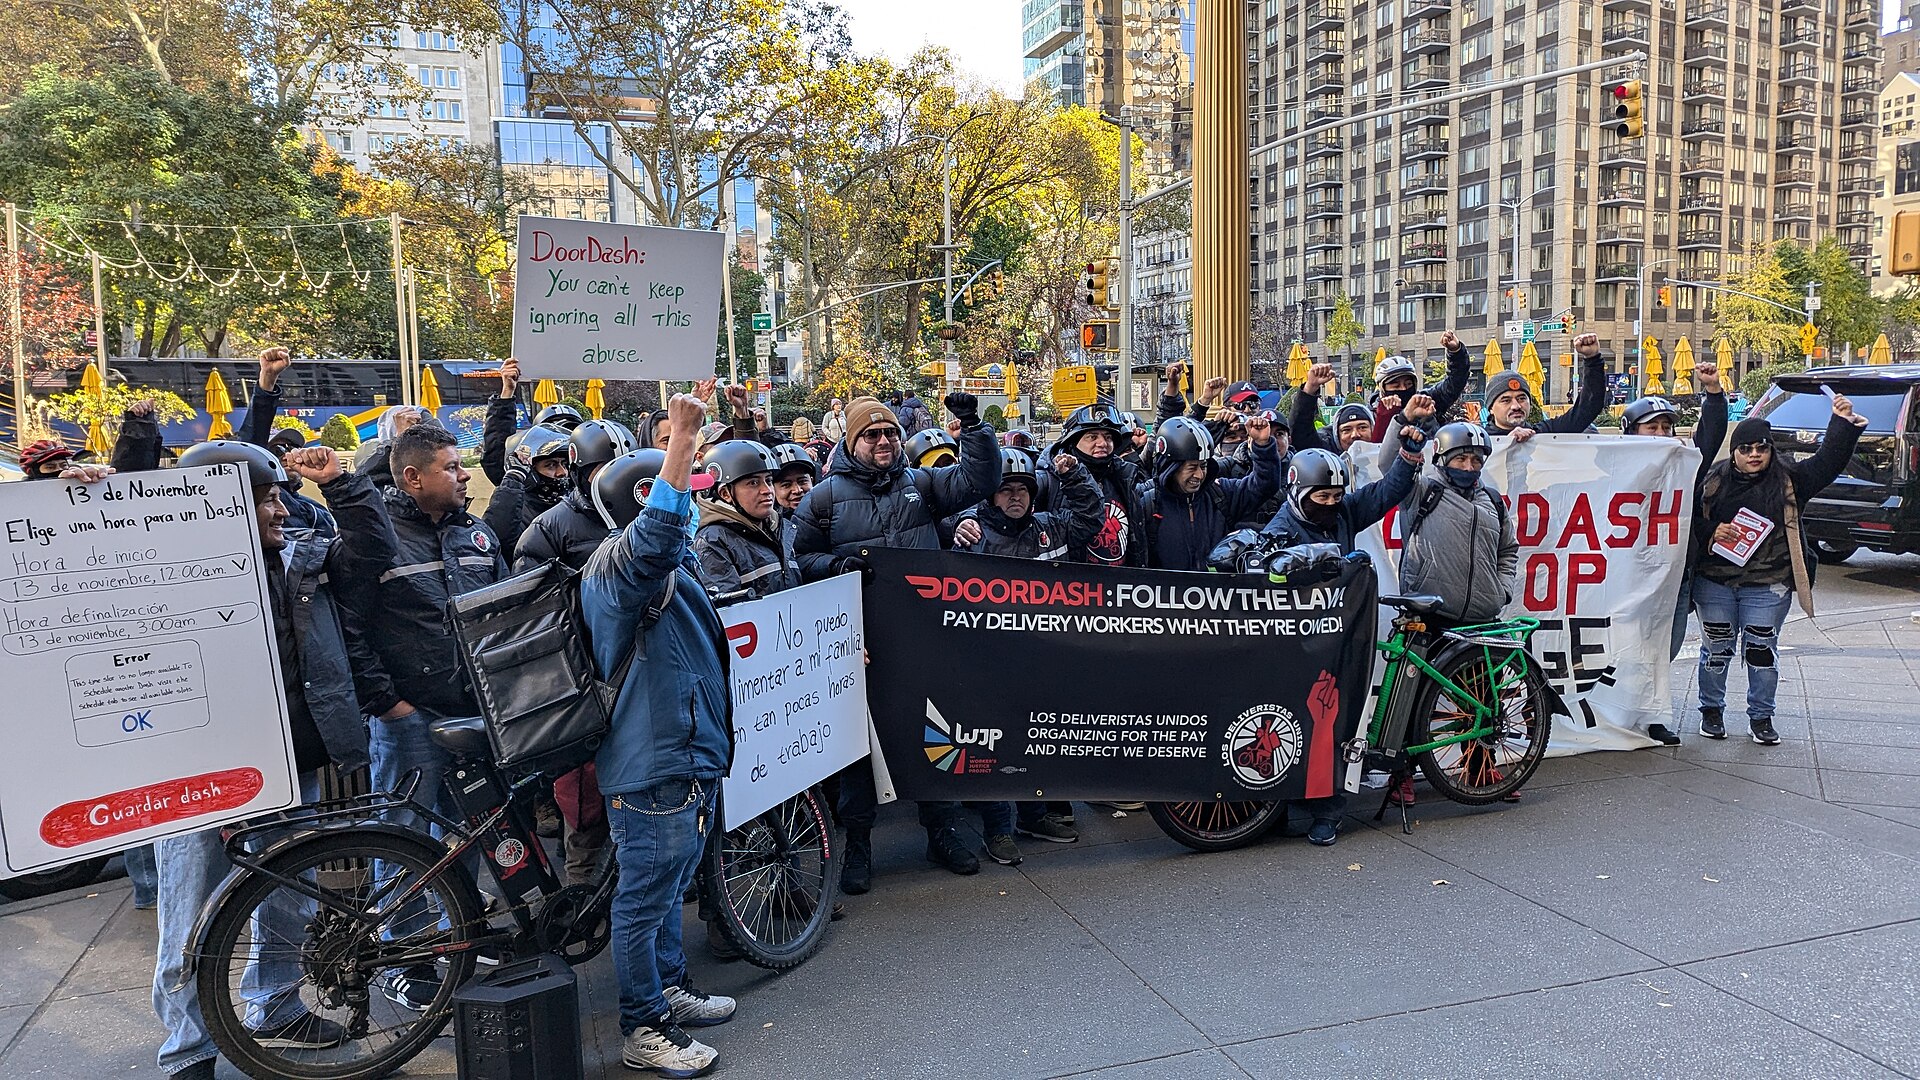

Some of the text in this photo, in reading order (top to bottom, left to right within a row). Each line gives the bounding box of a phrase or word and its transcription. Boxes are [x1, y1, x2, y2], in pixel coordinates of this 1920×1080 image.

[530, 231, 646, 264] DoorDash:
[545, 269, 580, 298] You
[586, 274, 630, 296] can't
[529, 307, 600, 333] ignoring
[614, 303, 637, 327] all
[582, 343, 643, 364] abuse.
[298, 408, 315, 416] NY
[65, 475, 208, 506] 13 de Noviembre
[6, 496, 245, 545] Elige una hora para un Dash
[12, 546, 158, 576] Hora de inicio
[12, 580, 40, 598] 13
[51, 576, 69, 593] de
[78, 570, 156, 591] noviembre,
[1116, 583, 1232, 612] FOLLOW
[1234, 587, 1292, 611] THE
[1523, 553, 1608, 616] OP
[3, 607, 50, 633] Hora
[775, 604, 848, 652] No puedo
[943, 611, 1345, 637] PAY DELIVERY WORKERS WHAT THEY'RE OWED!
[18, 634, 40, 648] 13
[46, 629, 62, 644] de
[67, 626, 131, 645] noviembre,
[113, 652, 151, 667] Error
[733, 624, 862, 708] limentar a mi familia
[70, 677, 86, 688] This
[138, 669, 156, 678] longer
[182, 661, 193, 670] To
[138, 680, 154, 690] Dash
[157, 678, 172, 687] visit
[176, 676, 188, 684] the
[140, 692, 148, 700] all
[148, 688, 174, 699] available
[733, 671, 855, 745] on tan pocas horas
[121, 709, 154, 733] OK
[1029, 711, 1208, 727] LOS DELIVERISTAS UNIDOS
[955, 722, 1004, 752] WJP
[1027, 727, 1208, 744] ORGANIZING FOR THE PAY
[1221, 704, 1304, 768] LOS DELIVERISTAS UNIDOS
[750, 721, 832, 783] de trabajo
[1024, 743, 1208, 759] AND RESPECT WE DESERVE
[88, 781, 221, 827] Guardar dash
[639, 1043, 660, 1052] FILA
